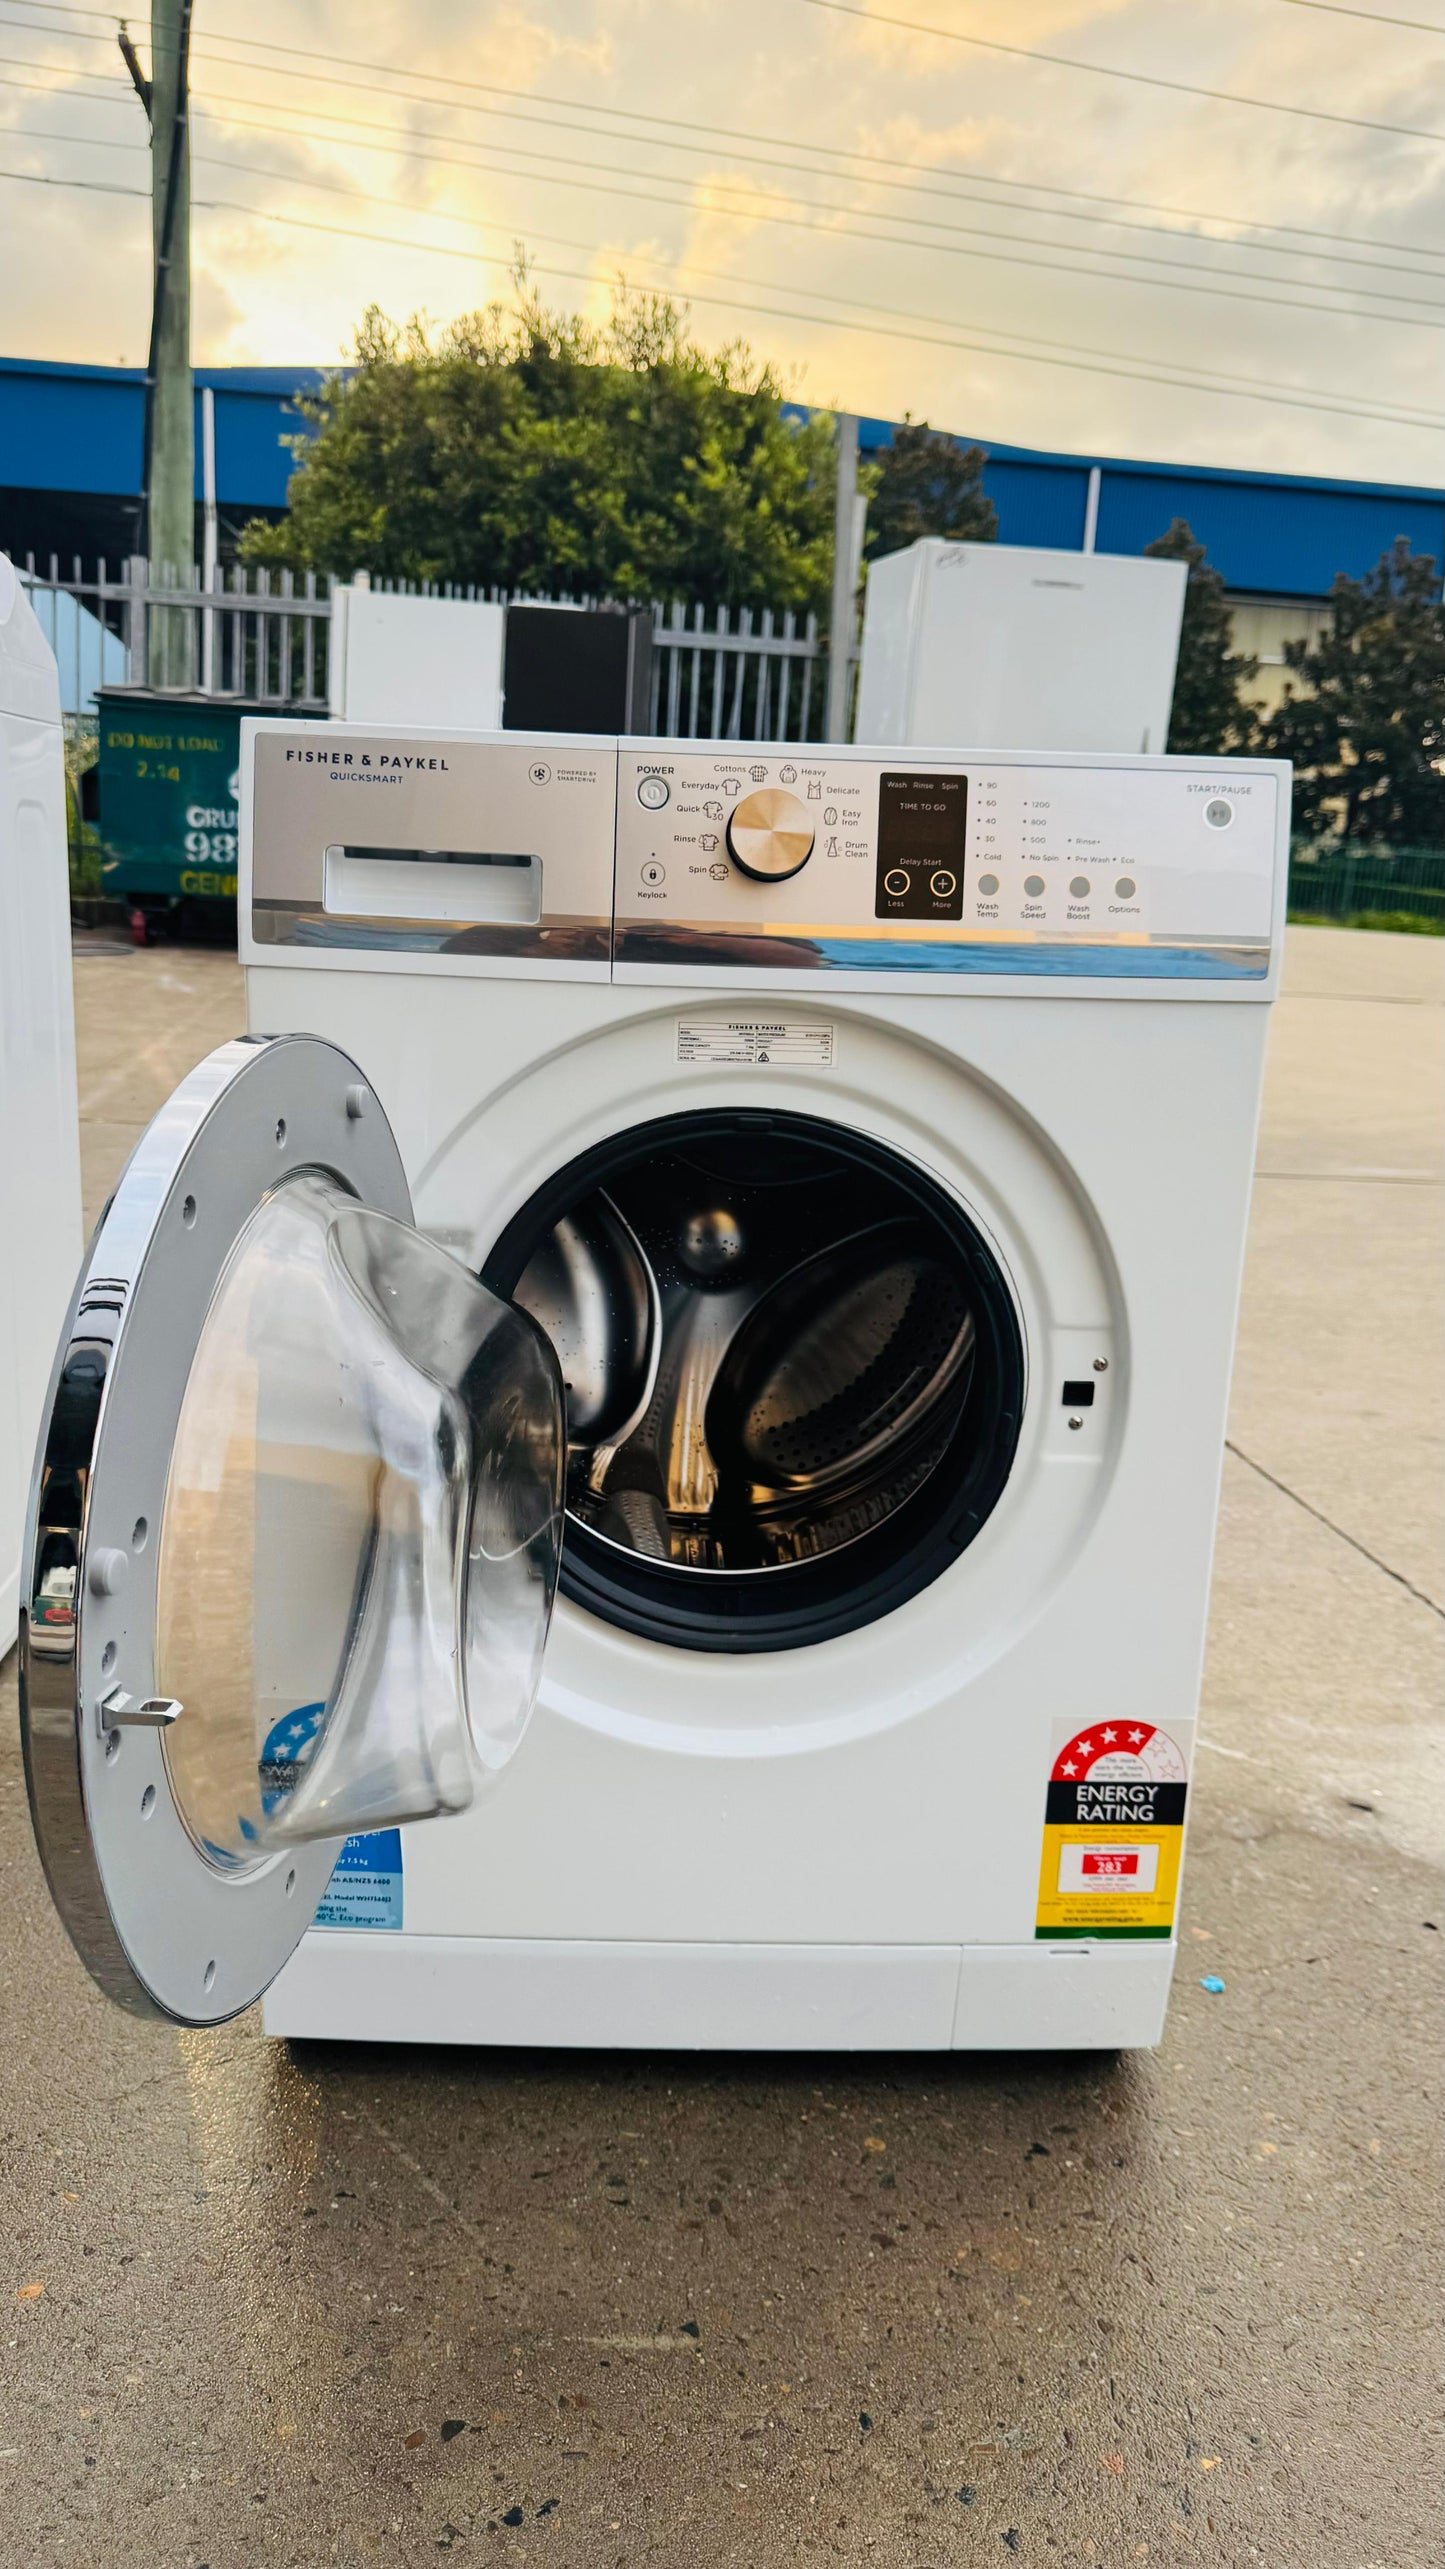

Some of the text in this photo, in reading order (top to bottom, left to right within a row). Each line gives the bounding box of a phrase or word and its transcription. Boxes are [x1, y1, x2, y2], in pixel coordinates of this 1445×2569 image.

[286, 750, 449, 771] FISHER & PAYKEL
[636, 765, 675, 775] POWER
[713, 764, 747, 773] Cottons
[801, 768, 827, 777] Heavy
[330, 772, 403, 784] QUICKSMART
[681, 781, 720, 791] Everyday
[826, 786, 860, 795] Delicate
[887, 781, 959, 791] Wash Rinse Spin
[1186, 784, 1253, 795] START/PAUSE
[676, 804, 701, 813] Quick
[900, 802, 918, 811] TIME
[921, 803, 932, 811] TO
[712, 813, 724, 821] 30
[842, 809, 861, 818] Easy
[673, 834, 697, 843] Rinse
[184, 831, 238, 862] 98
[845, 841, 868, 849] Drum
[844, 850, 868, 858] Clean
[983, 853, 1002, 861] Cold
[1042, 854, 1059, 862] Spin
[900, 858, 942, 866] Delay Start
[688, 865, 707, 874] Spin
[637, 891, 667, 899] Keylock
[1024, 903, 1043, 912] Spin
[1067, 904, 1090, 912] Wash
[1107, 905, 1141, 914] Options
[976, 910, 999, 919] Temp
[1020, 911, 1047, 920] Speed
[1066, 912, 1090, 920] Boost
[1076, 1785, 1159, 1802] ENERGY
[1076, 1804, 1155, 1821] RATING
[1097, 1861, 1122, 1873] 283
